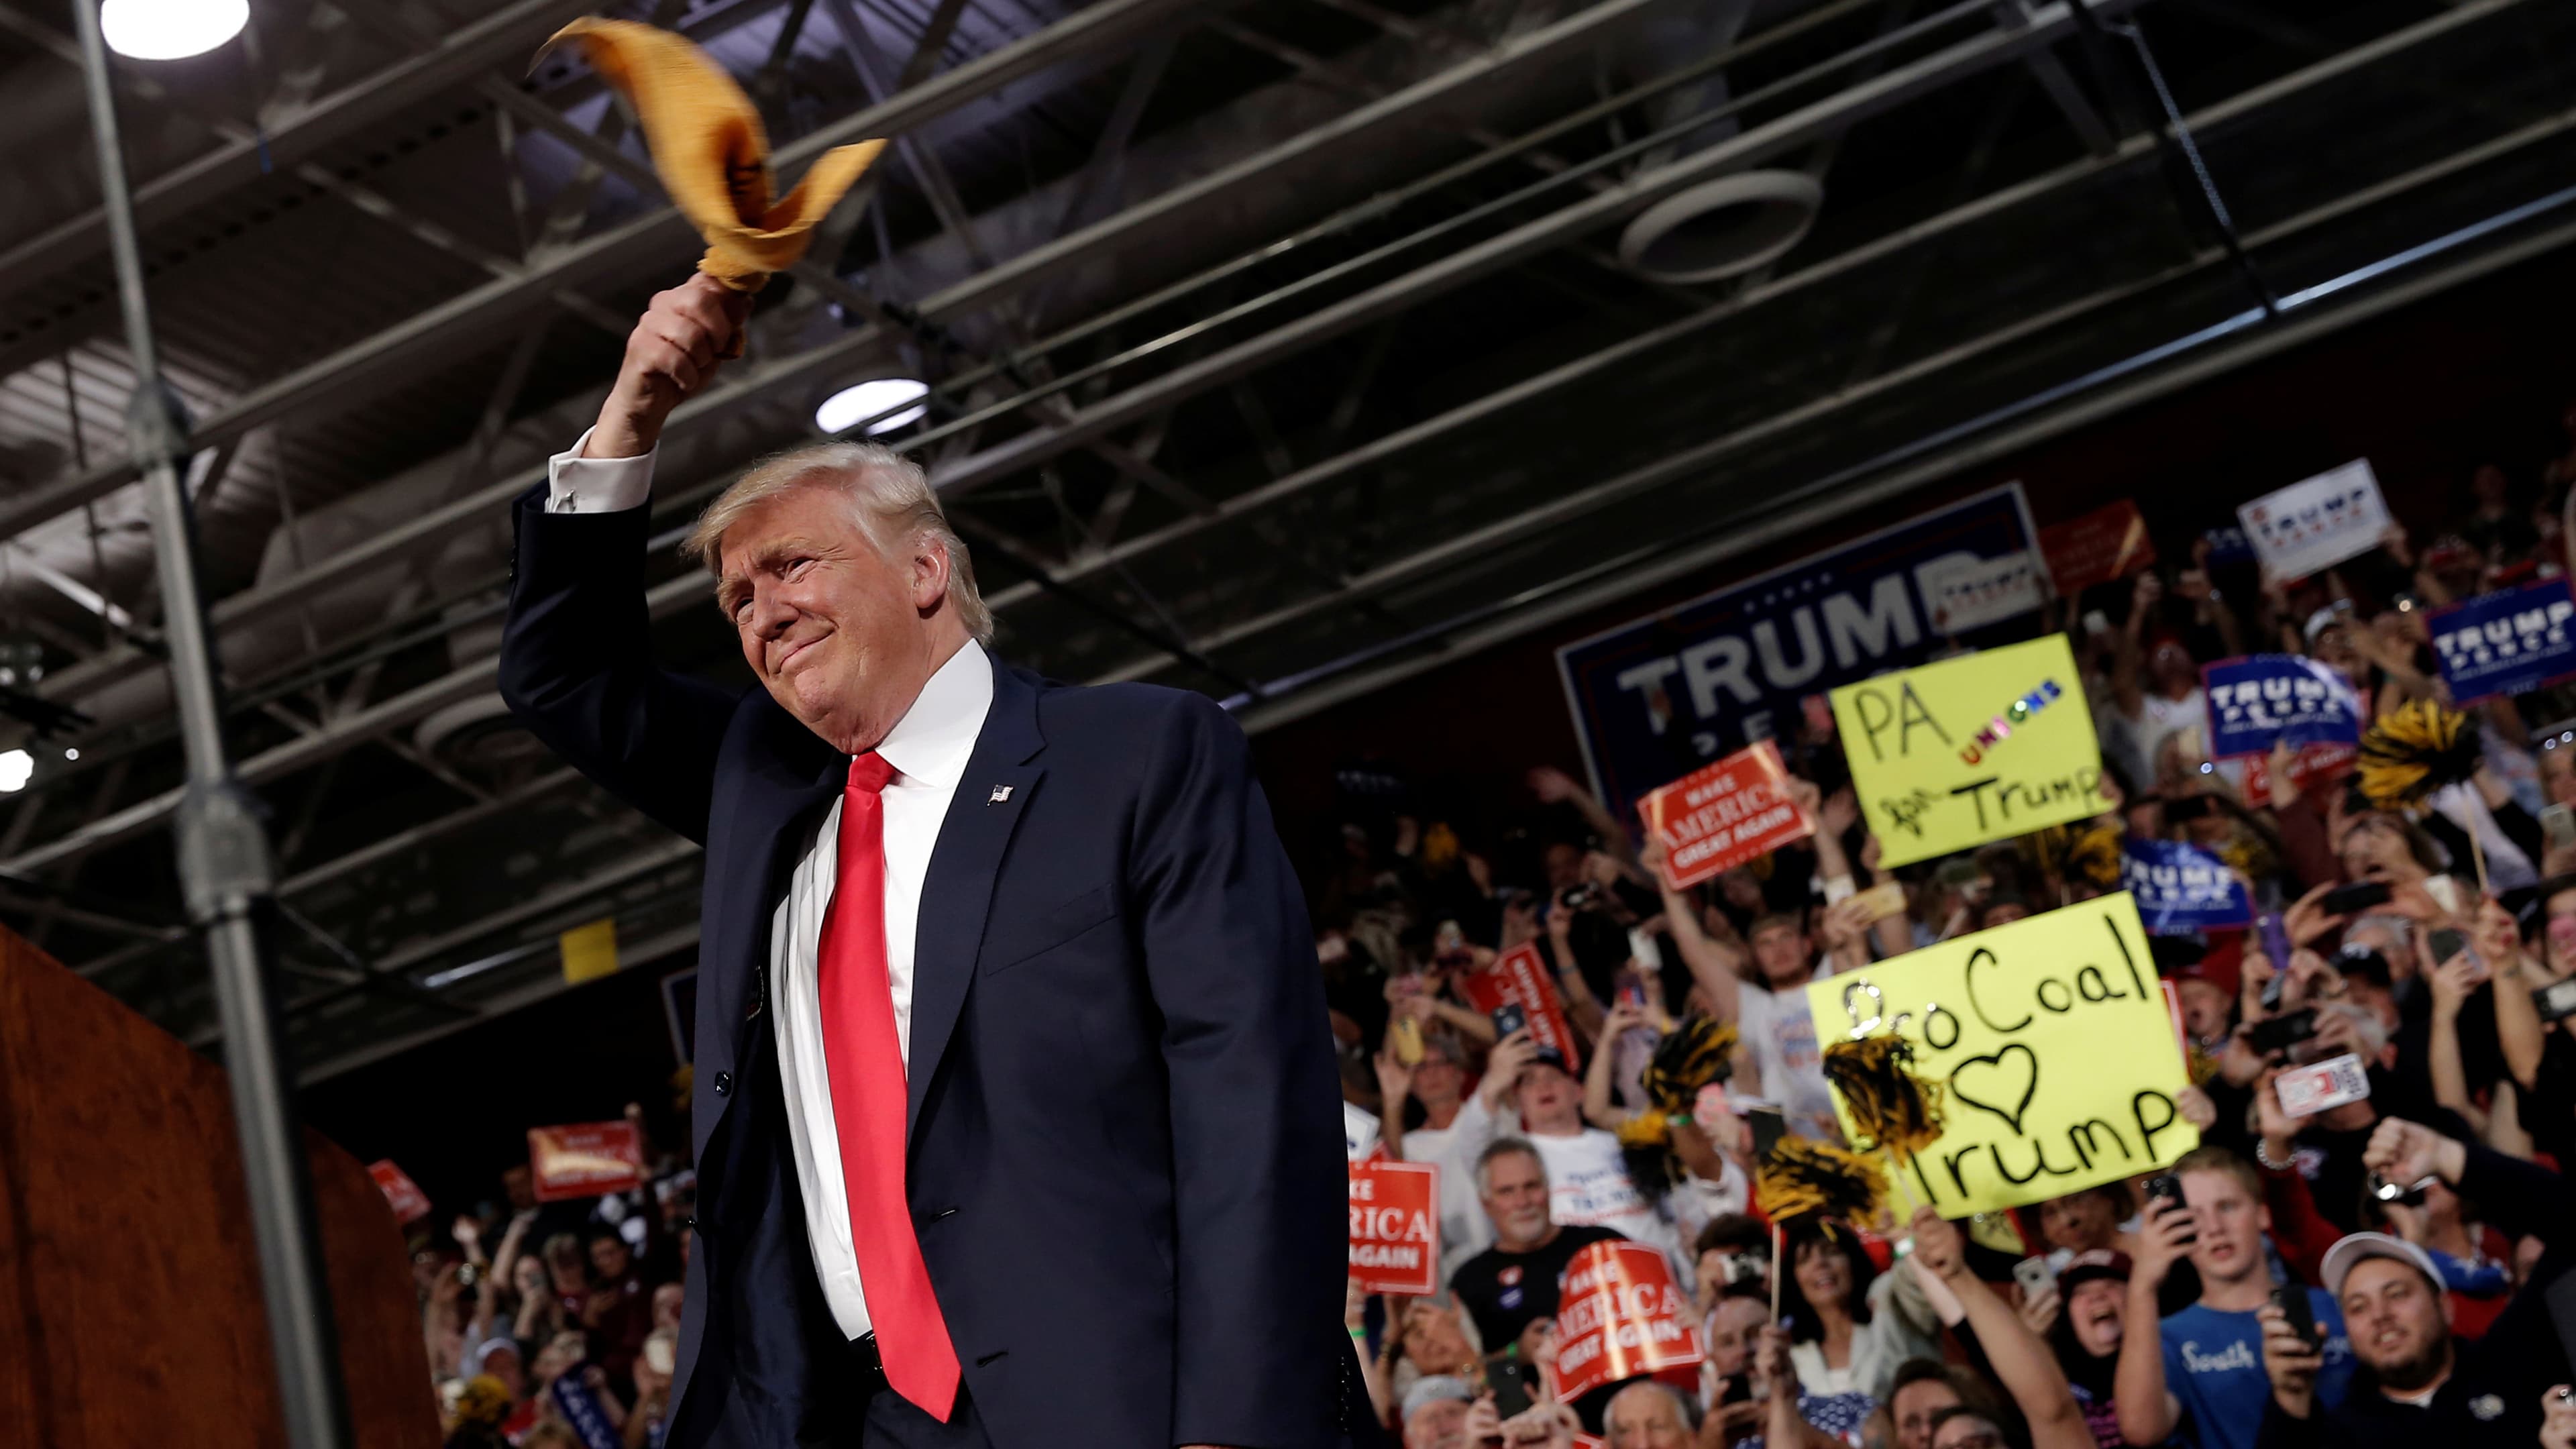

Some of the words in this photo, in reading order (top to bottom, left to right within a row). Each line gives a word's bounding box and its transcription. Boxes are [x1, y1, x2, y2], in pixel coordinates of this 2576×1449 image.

[2434, 600, 2575, 658] TRUMP
[1854, 678, 1954, 762] PA
[1949, 765, 2102, 831] Trump
[1966, 914, 2149, 1033] Coal
[1558, 1282, 1682, 1339] MERICA
[2182, 1340, 2256, 1373] South
